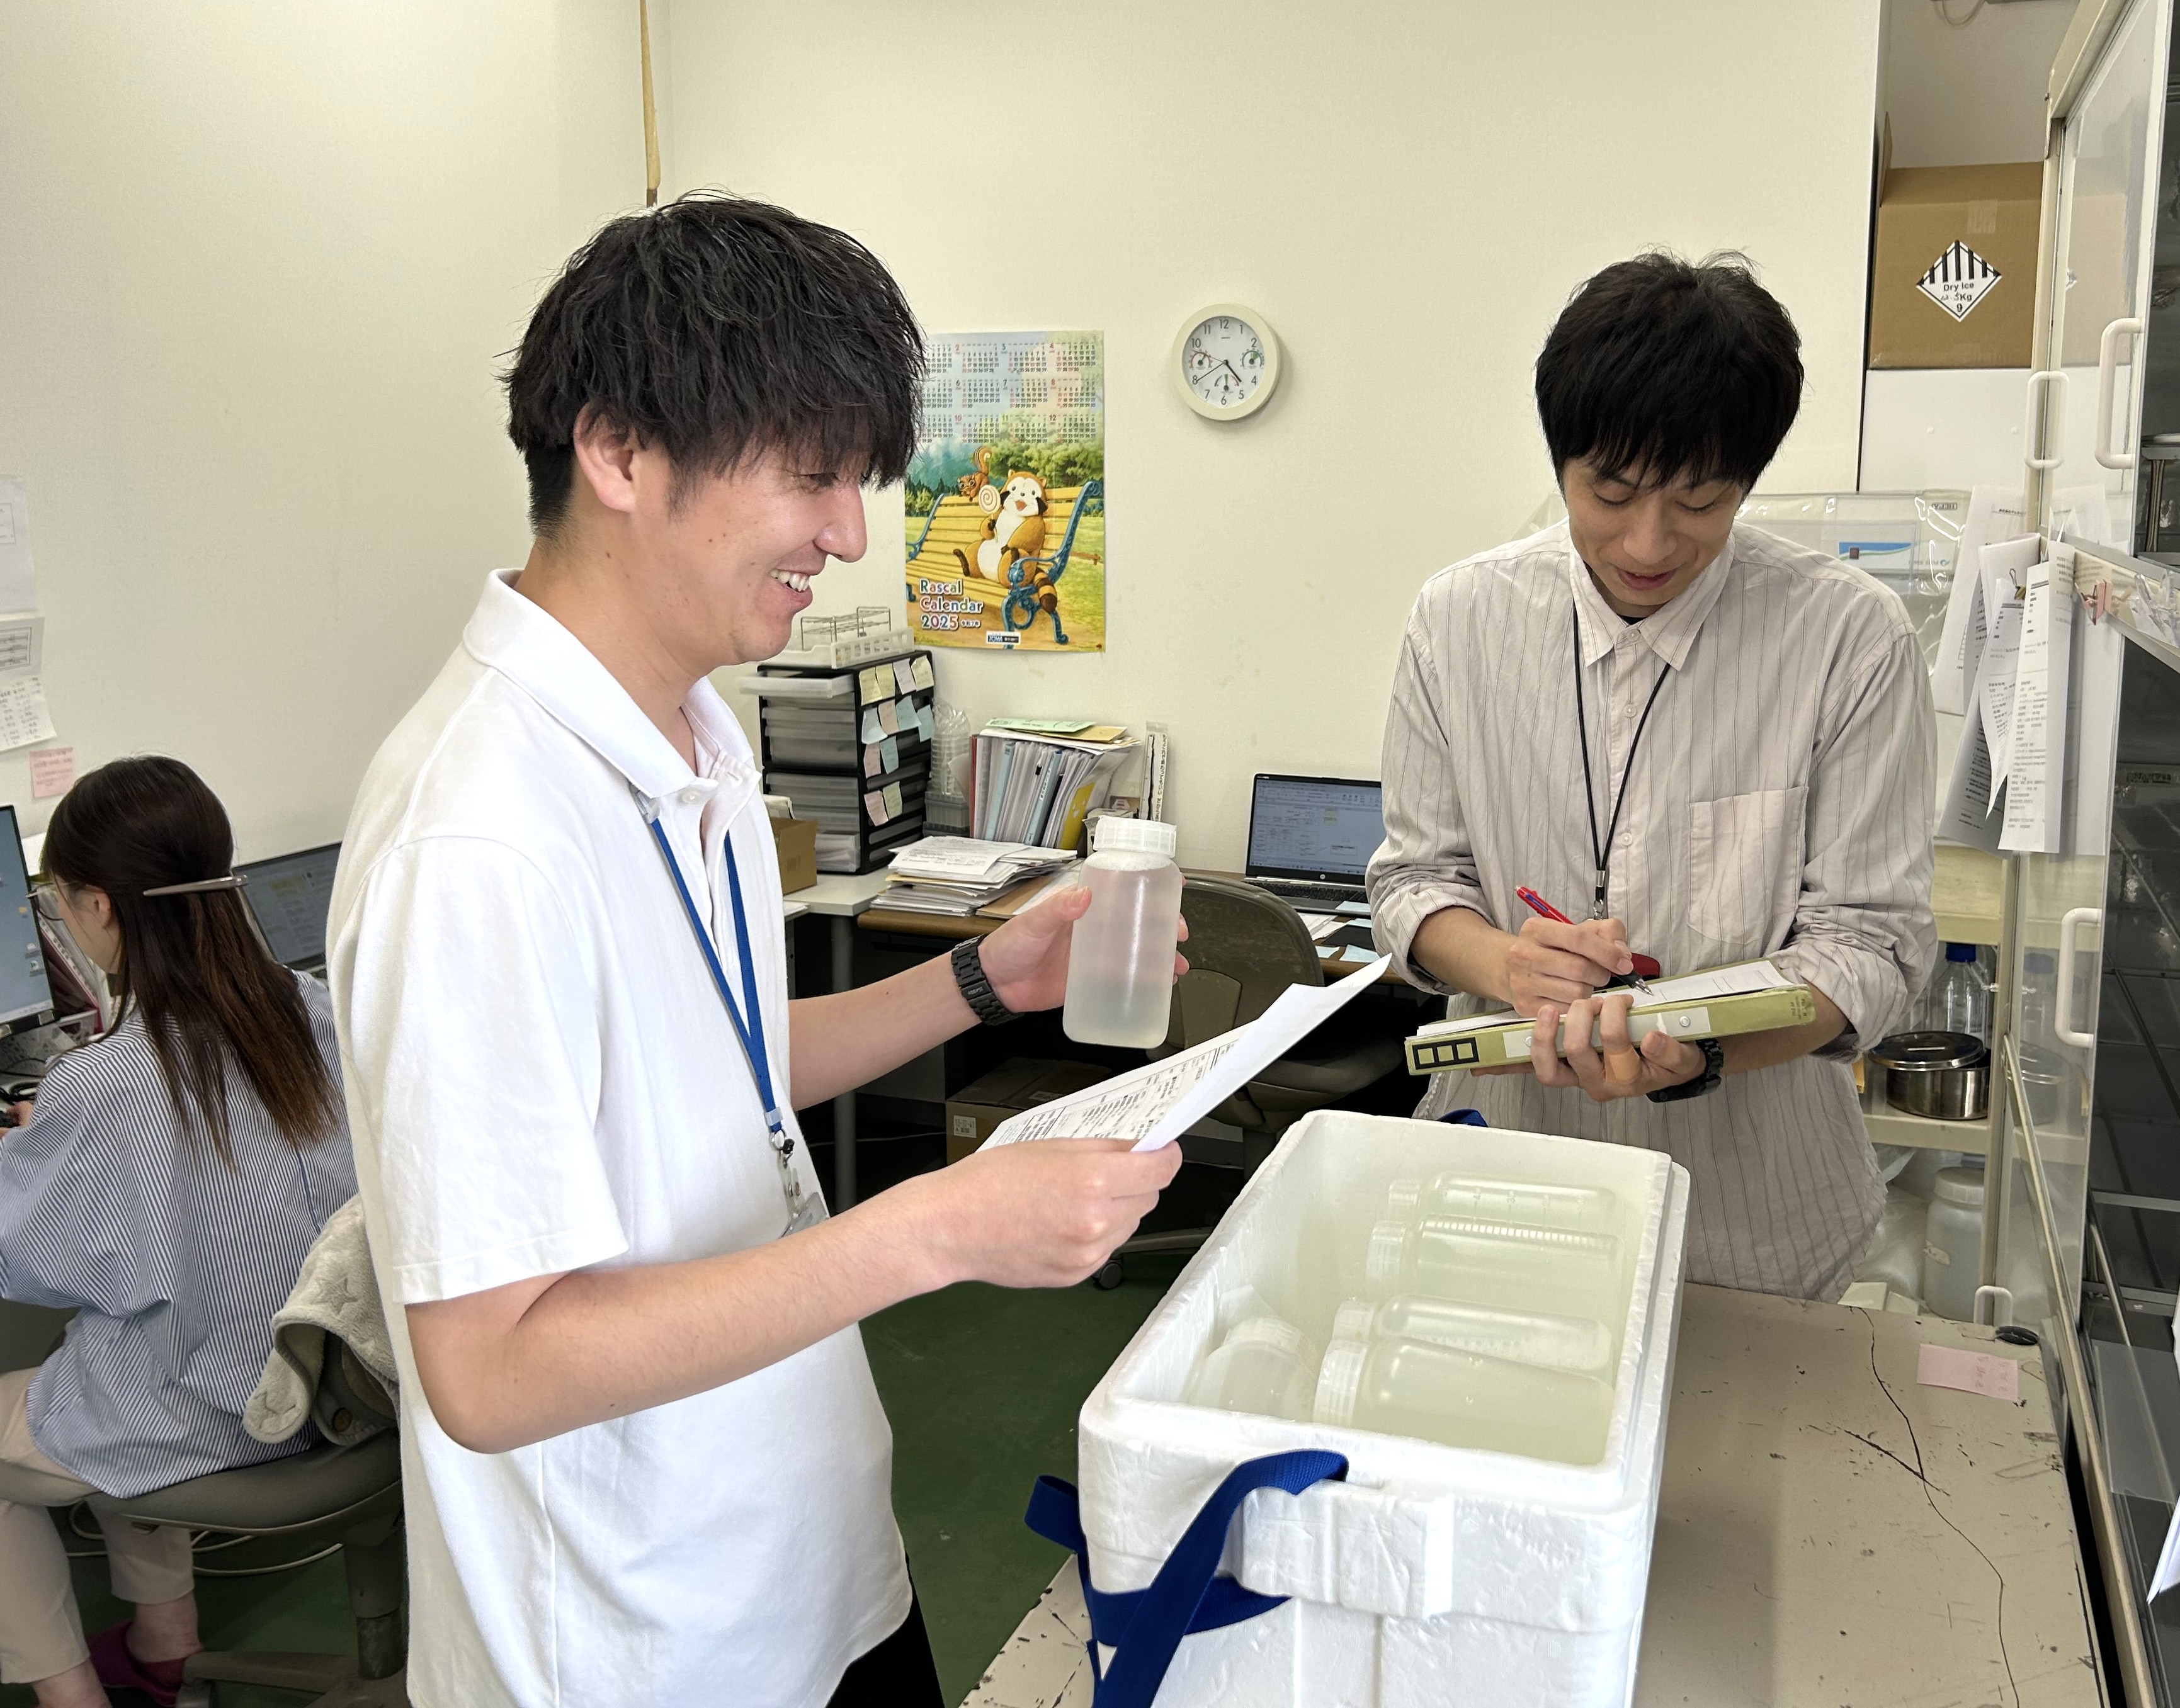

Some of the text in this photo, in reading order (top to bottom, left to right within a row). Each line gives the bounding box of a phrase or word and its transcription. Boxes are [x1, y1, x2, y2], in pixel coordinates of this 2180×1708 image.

[1944, 283, 1959, 291] Dry
[1956, 303, 1963, 312] 9
[1220, 319, 1229, 329] 12
[1239, 324, 1243, 334] 1
[1204, 325, 1211, 334] 11
[1191, 338, 1201, 348] 10
[1251, 338, 1257, 348] 2
[1193, 375, 1198, 385] 8
[1251, 376, 1257, 385] 4
[1205, 390, 1210, 399] 7
[1239, 390, 1244, 399] 5
[1222, 396, 1227, 405] 6
[921, 579, 962, 594] Rascal
[921, 597, 983, 612] Calendar
[922, 614, 958, 628] 2025
